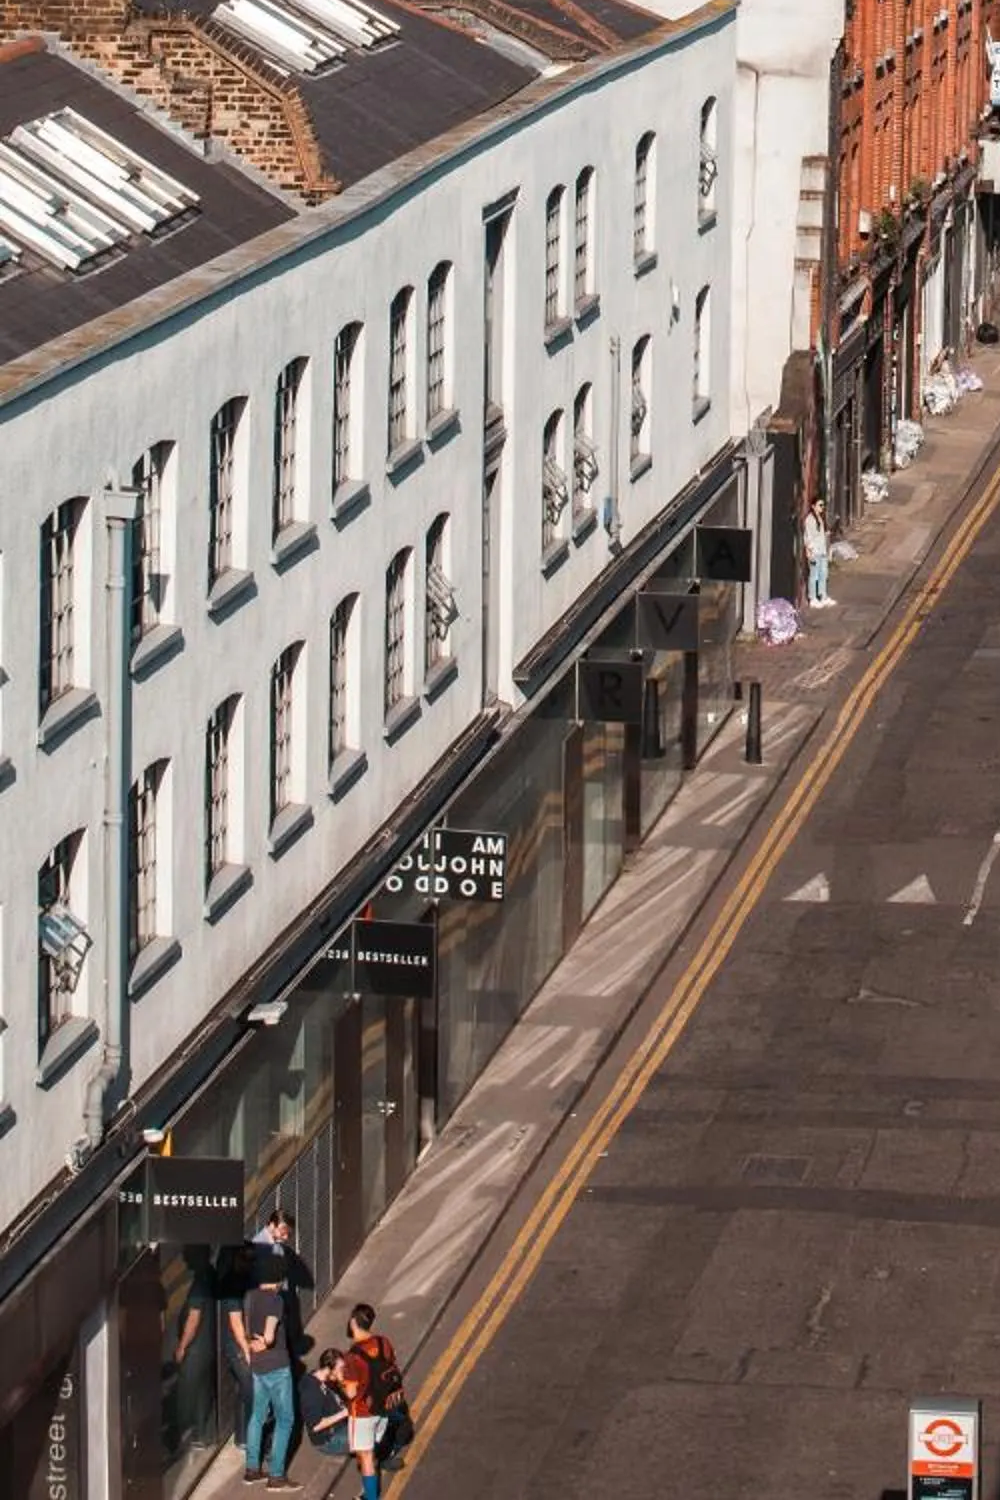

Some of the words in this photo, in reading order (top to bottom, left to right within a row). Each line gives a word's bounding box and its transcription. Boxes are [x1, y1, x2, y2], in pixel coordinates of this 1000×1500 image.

[653, 600, 685, 633] V
[598, 671, 623, 707] R
[435, 833, 441, 850] I
[471, 835, 504, 855] AM
[434, 855, 503, 877] JOHN
[434, 876, 503, 899] DOE
[357, 951, 429, 967] BESTSELLER
[153, 1193, 238, 1208] BESTSELLER
